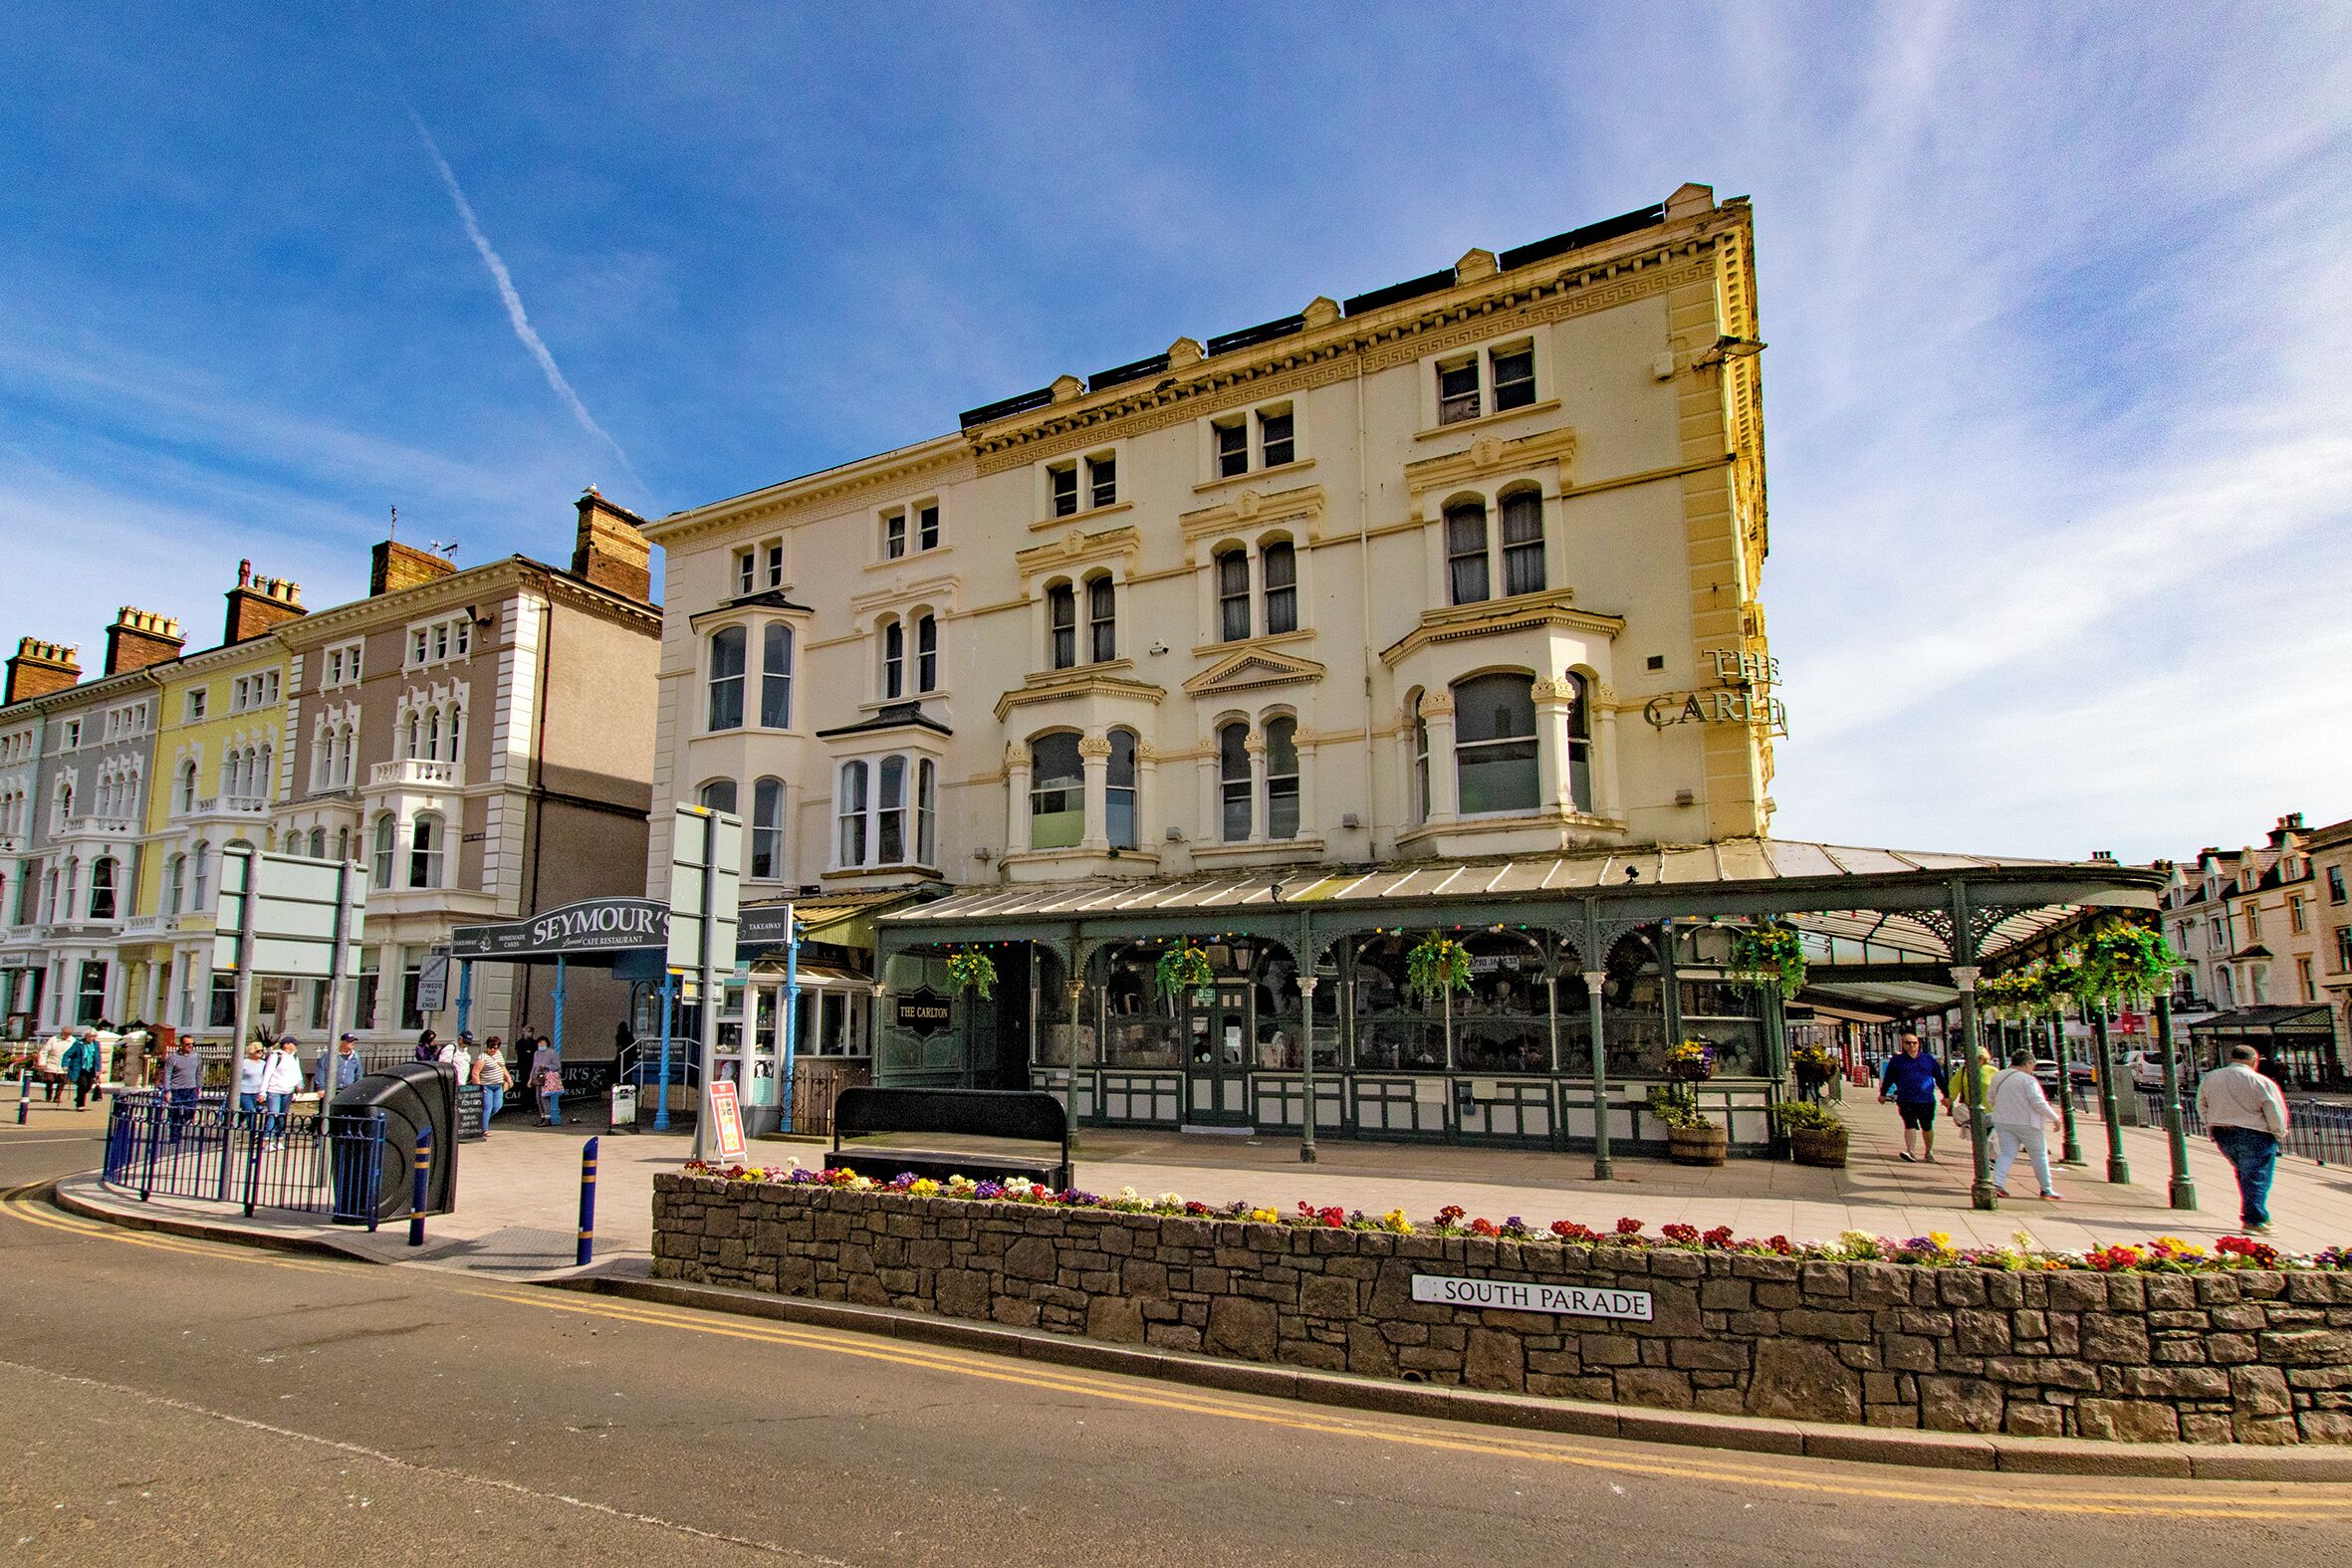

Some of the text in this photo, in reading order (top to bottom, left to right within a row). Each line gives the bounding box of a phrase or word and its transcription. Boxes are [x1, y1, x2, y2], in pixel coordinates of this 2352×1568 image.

[1702, 648, 1782, 686] THE
[749, 922, 782, 931] TAKEAWAY
[599, 935, 643, 945] RESTAURANT
[899, 1006, 949, 1018] THE CARLTON
[1445, 1280, 1648, 1316] SOUTH PARADE
